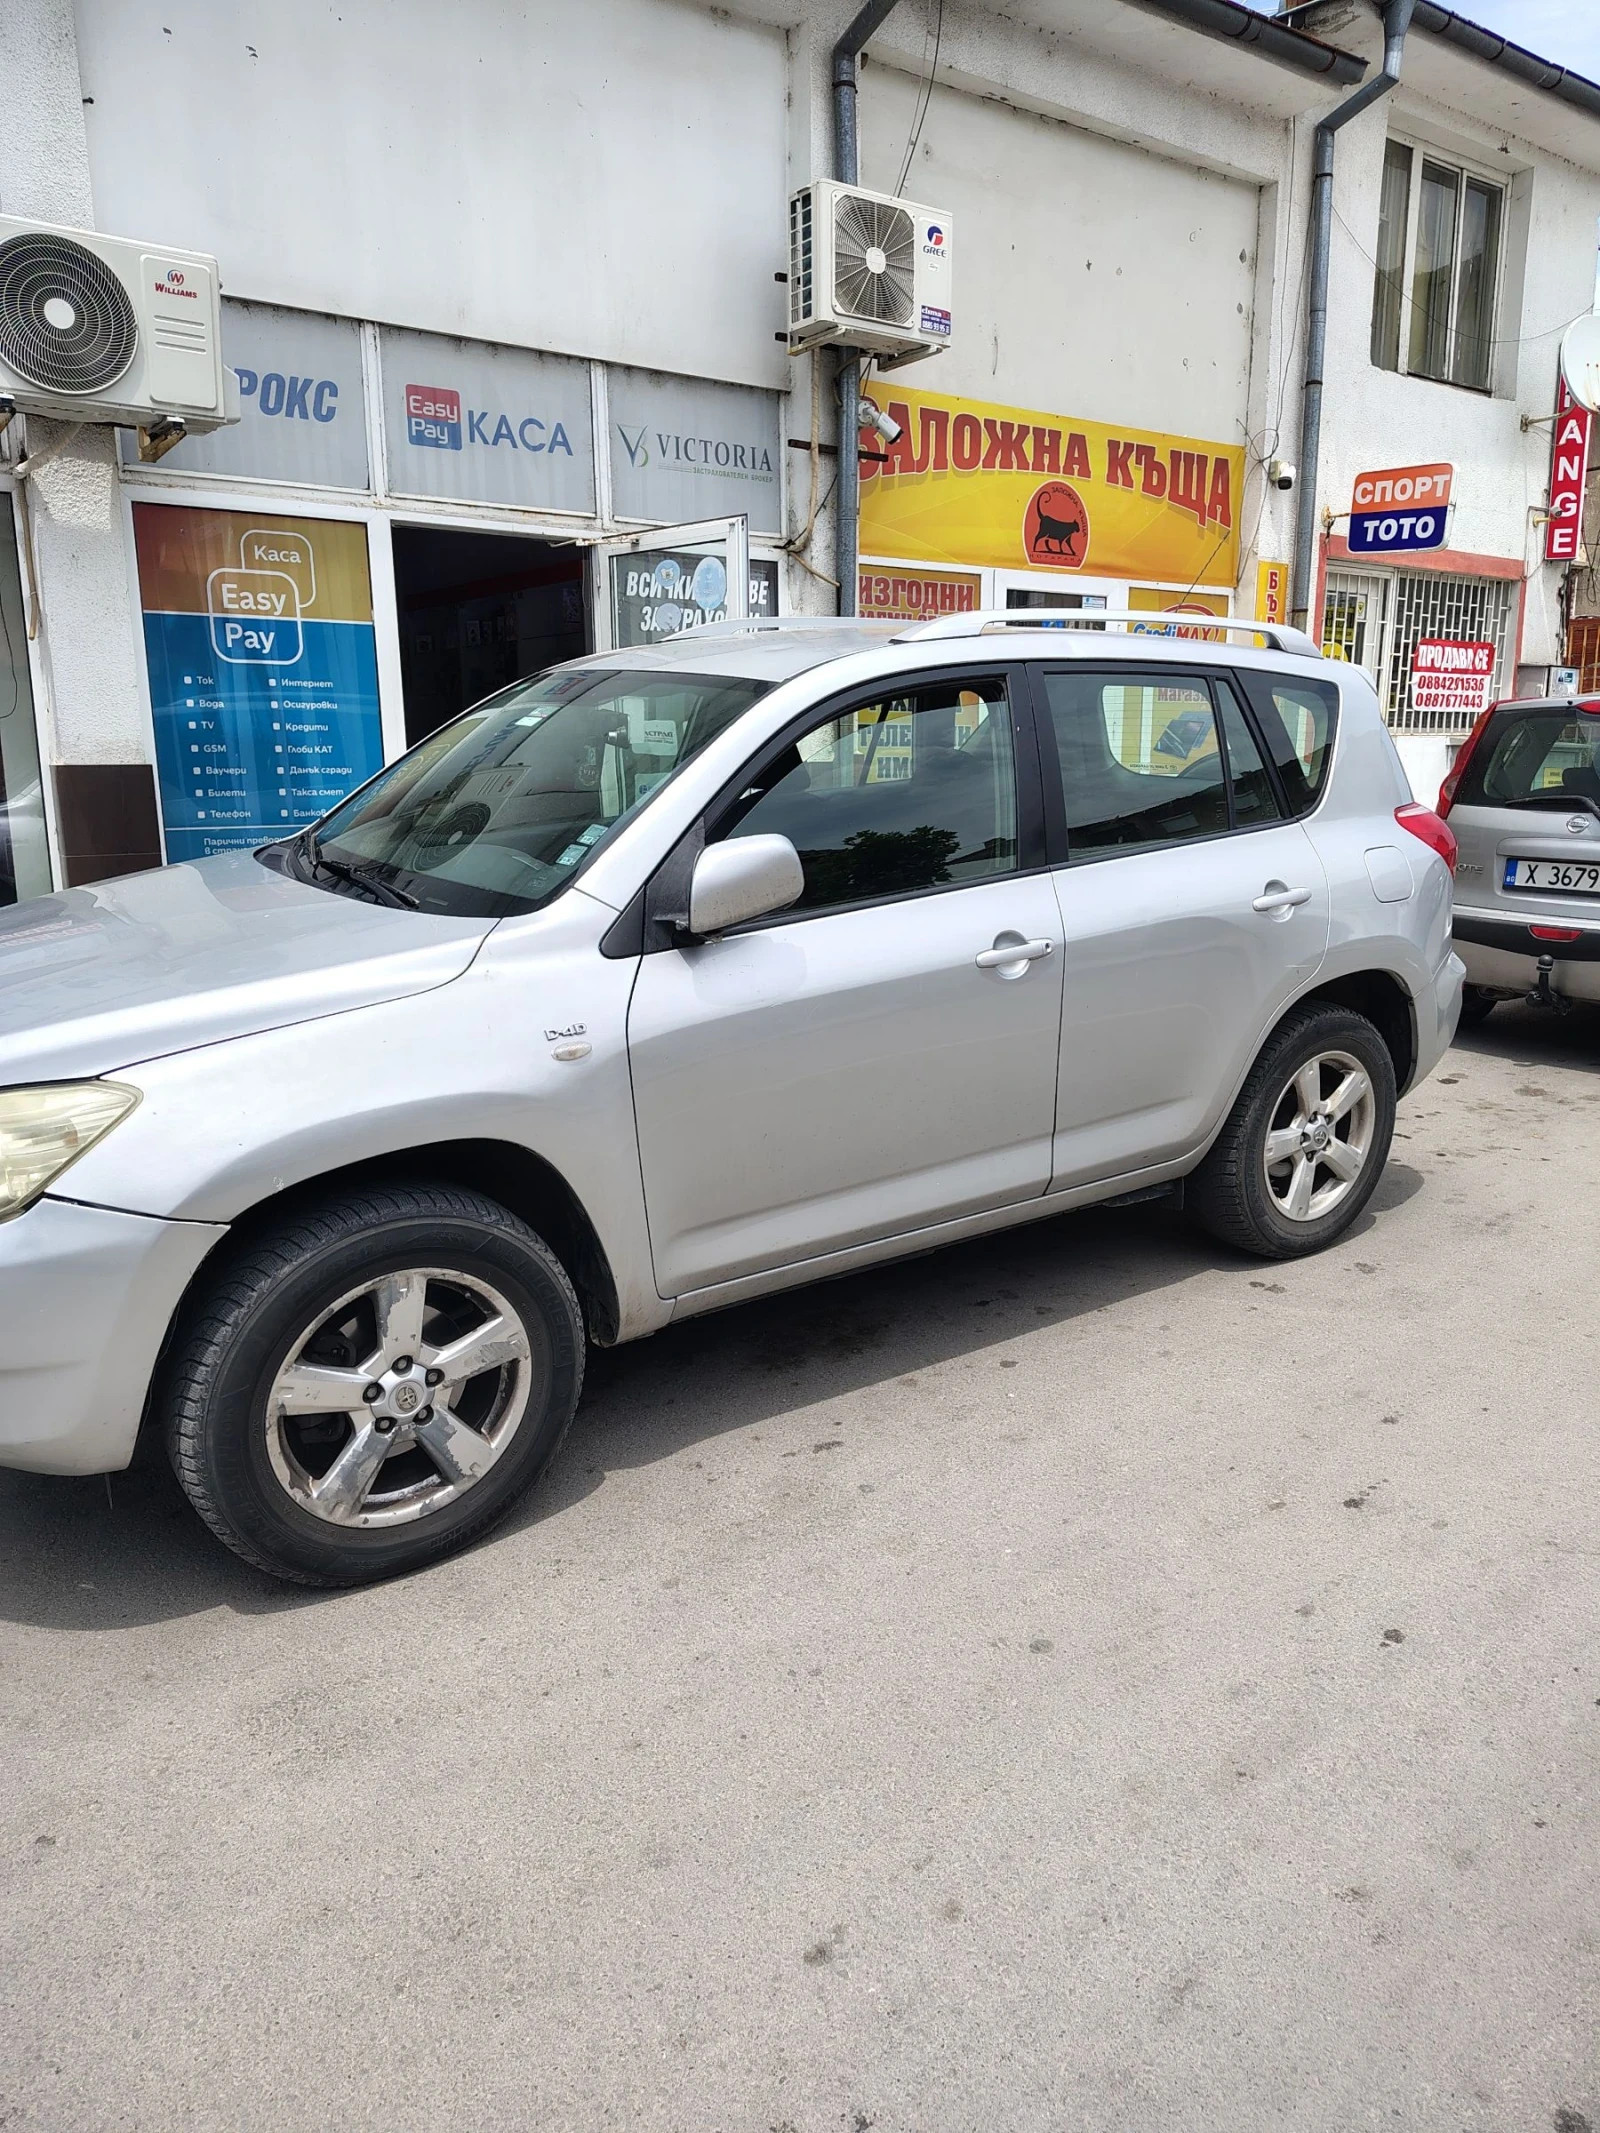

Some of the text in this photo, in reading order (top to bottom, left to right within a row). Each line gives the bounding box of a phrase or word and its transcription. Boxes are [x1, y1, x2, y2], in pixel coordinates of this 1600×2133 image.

[923, 244, 948, 258] GREE
[155, 282, 198, 299] WILLIAMS
[409, 395, 458, 423] Easy
[411, 418, 449, 445] Pay
[468, 410, 574, 456] КАСА
[656, 433, 773, 472] VICTORIA
[692, 467, 773, 483] ЗАСТРАХОВАТЕЛЕН БРОКЕР
[1552, 393, 1584, 554] ANGE
[1106, 438, 1232, 529] КЪЩА
[1355, 474, 1450, 505] СПОРТ
[1363, 515, 1436, 542] ТОТО
[254, 545, 302, 564] Каса
[221, 583, 286, 615] Easy
[859, 575, 974, 615] ИЗГОДНИ
[224, 623, 275, 653] Pay
[1417, 645, 1489, 672] ПРОДАВА СЕ
[196, 676, 215, 685] Ток
[281, 678, 333, 688] Интернет
[199, 699, 225, 709] Вода
[283, 700, 338, 710] Осигуровки
[201, 721, 215, 729] TV
[285, 722, 329, 732] Кредити
[203, 744, 227, 753] GSM
[287, 745, 333, 754] Глоби КАТ
[205, 766, 247, 775] Ваучери
[289, 765, 352, 776] Данък сгради
[208, 788, 247, 797] Билети
[291, 787, 318, 796] Такса
[210, 809, 251, 818] Телефон
[204, 837, 245, 847] Парични
[1506, 875, 1516, 883] BG
[1548, 866, 1600, 889] 3679
